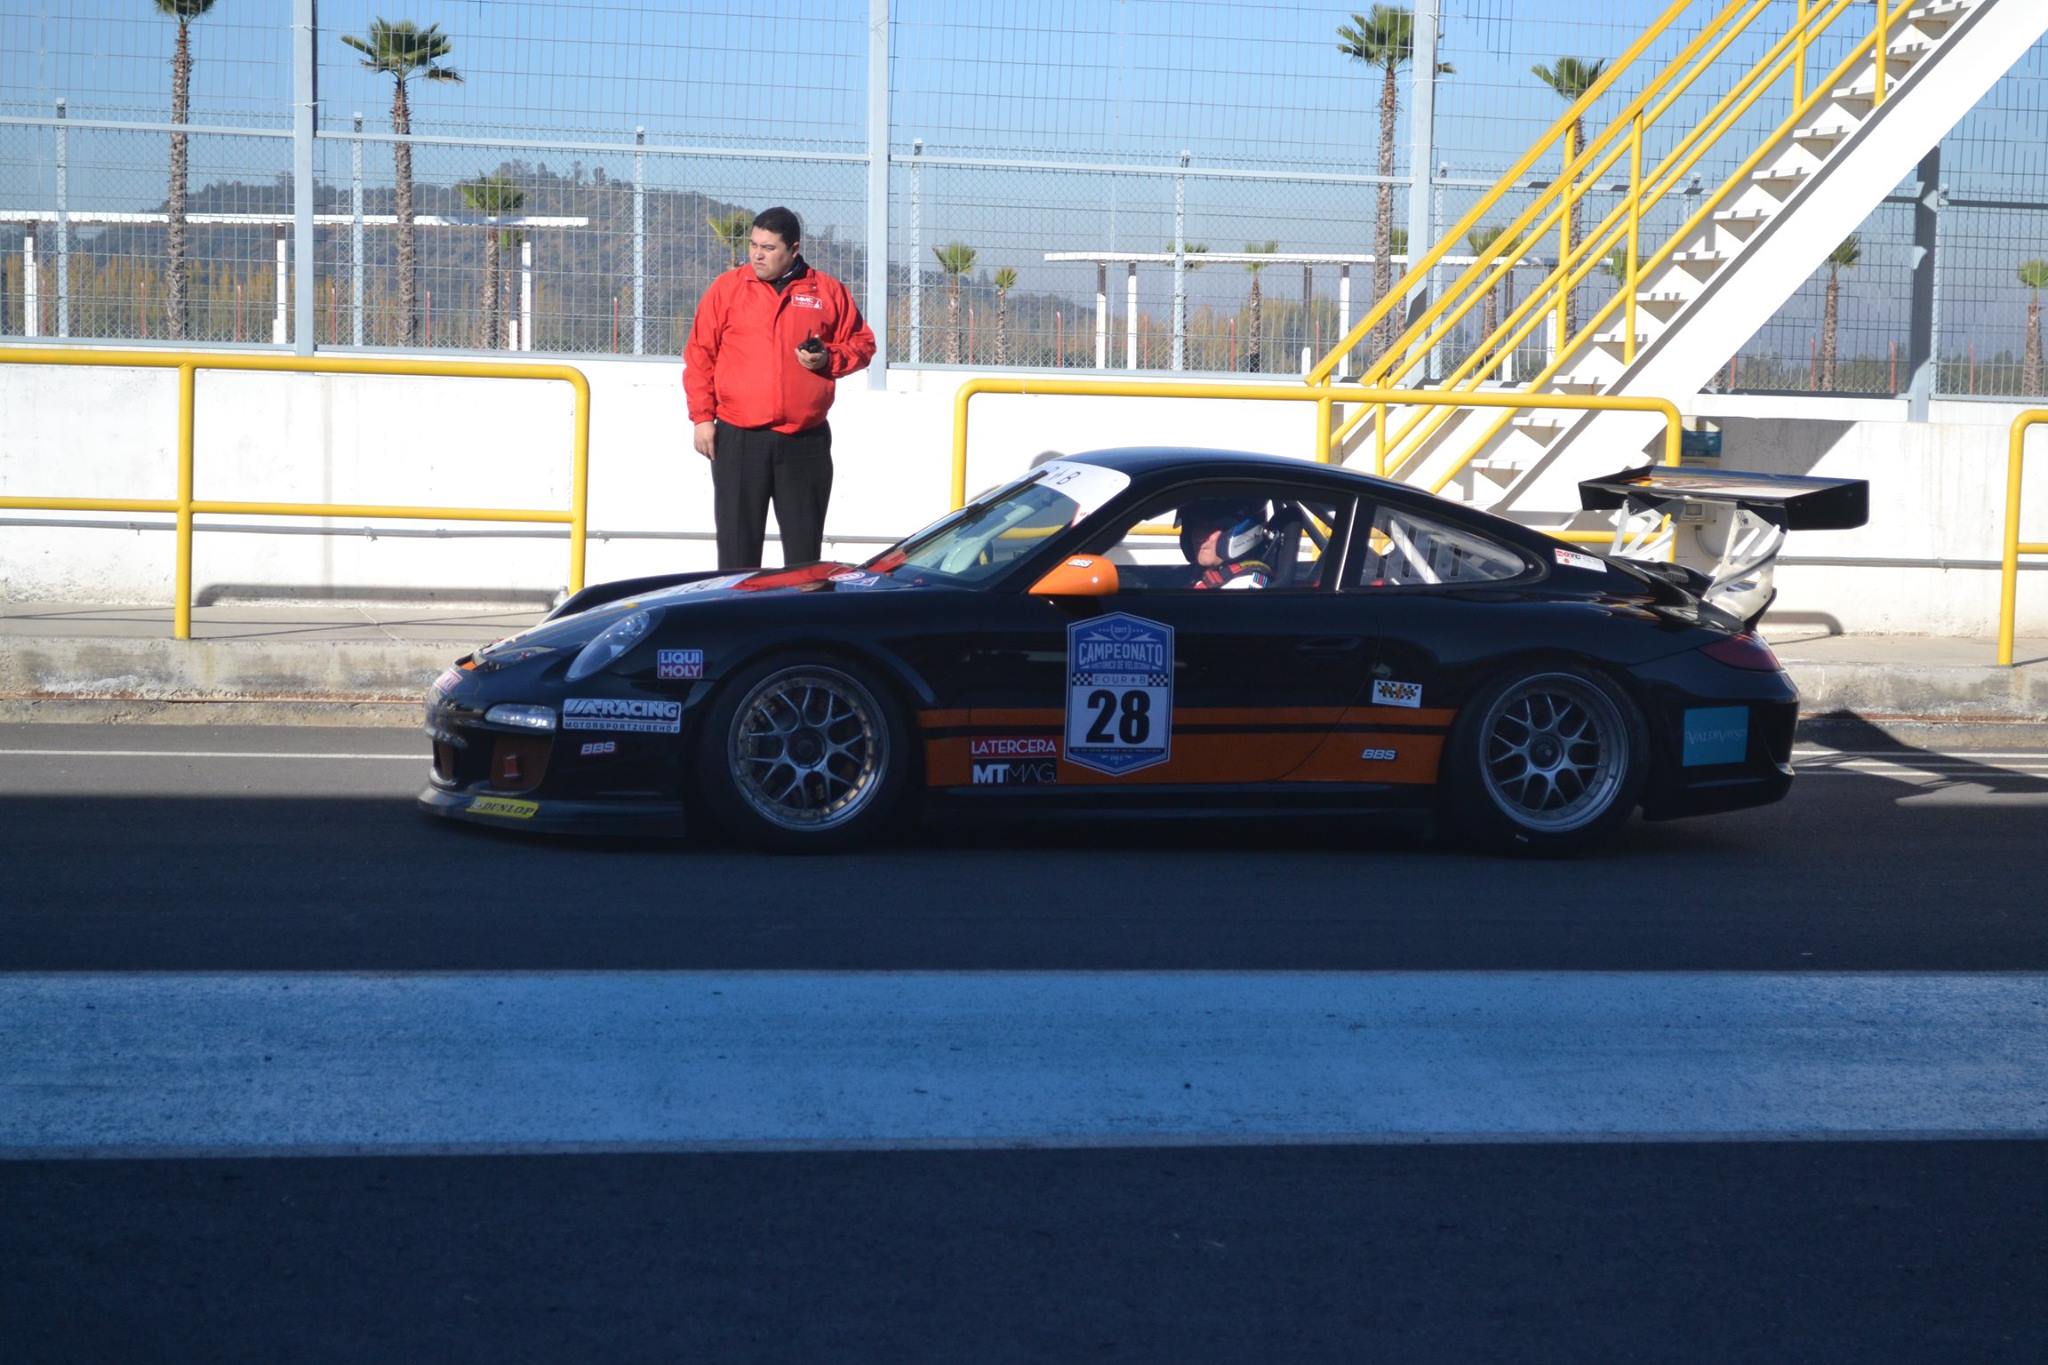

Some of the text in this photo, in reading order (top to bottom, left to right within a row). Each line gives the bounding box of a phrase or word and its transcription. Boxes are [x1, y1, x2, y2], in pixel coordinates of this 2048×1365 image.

[660, 651, 699, 664] LIQUI
[1078, 642, 1163, 666] CAMPEONATO
[660, 664, 699, 677] MOLY
[1086, 689, 1150, 745] 28
[580, 741, 616, 756] BBS
[1361, 748, 1397, 760] BBS
[482, 801, 536, 815] DUNLOP
